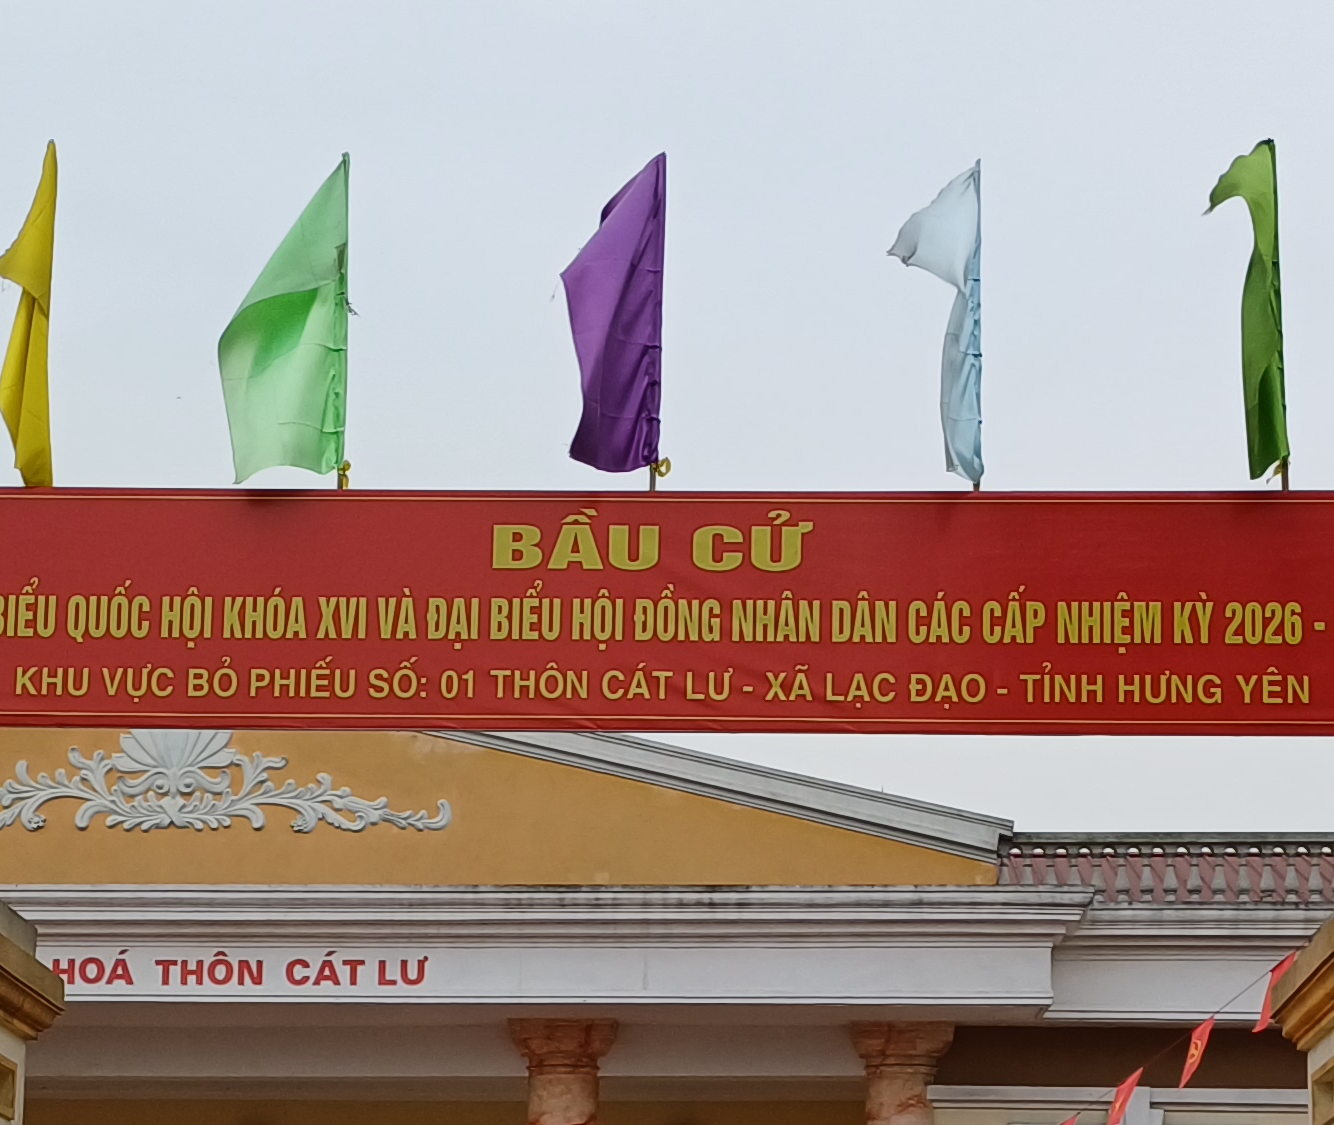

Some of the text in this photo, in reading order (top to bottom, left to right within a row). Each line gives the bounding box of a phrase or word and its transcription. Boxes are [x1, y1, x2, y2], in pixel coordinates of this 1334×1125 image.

[492, 508, 814, 572] BẦU CỬ
[67, 579, 151, 643] QUỐC
[160, 588, 213, 649] HỘI
[222, 586, 307, 639] KHÓA
[317, 597, 367, 639] XVI
[378, 587, 417, 640] VÀ
[426, 597, 480, 650] ĐẠI
[490, 579, 561, 641] BIỂU
[571, 589, 624, 651] HỘI
[634, 581, 721, 642] ĐỒNG
[731, 591, 821, 643] NHÂN
[831, 591, 897, 643] DÂN
[908, 590, 971, 644] CÁC
[982, 582, 1046, 645] CẤP
[1057, 593, 1162, 654] NHIỆM
[1173, 592, 1215, 645] KỲ
[1224, 602, 1303, 645] 2026
[15, 667, 89, 696] KHU
[102, 666, 174, 701] VỰC
[187, 656, 238, 698] BỎ
[250, 656, 356, 698] PHIẾU
[368, 656, 427, 699] SỐ:
[440, 670, 474, 699] 01
[490, 663, 588, 699] THÔN
[602, 662, 674, 700] CÁT
[686, 667, 732, 701] LƯ
[767, 666, 813, 701] XÃ
[826, 672, 896, 709] LẠC
[908, 673, 986, 710] ĐẠO
[1020, 661, 1103, 703] TỈNH
[1118, 671, 1222, 704] HƯNG
[1236, 667, 1309, 704] YÊN
[52, 949, 429, 986] HOÁ THÔN CÁT LƯ
